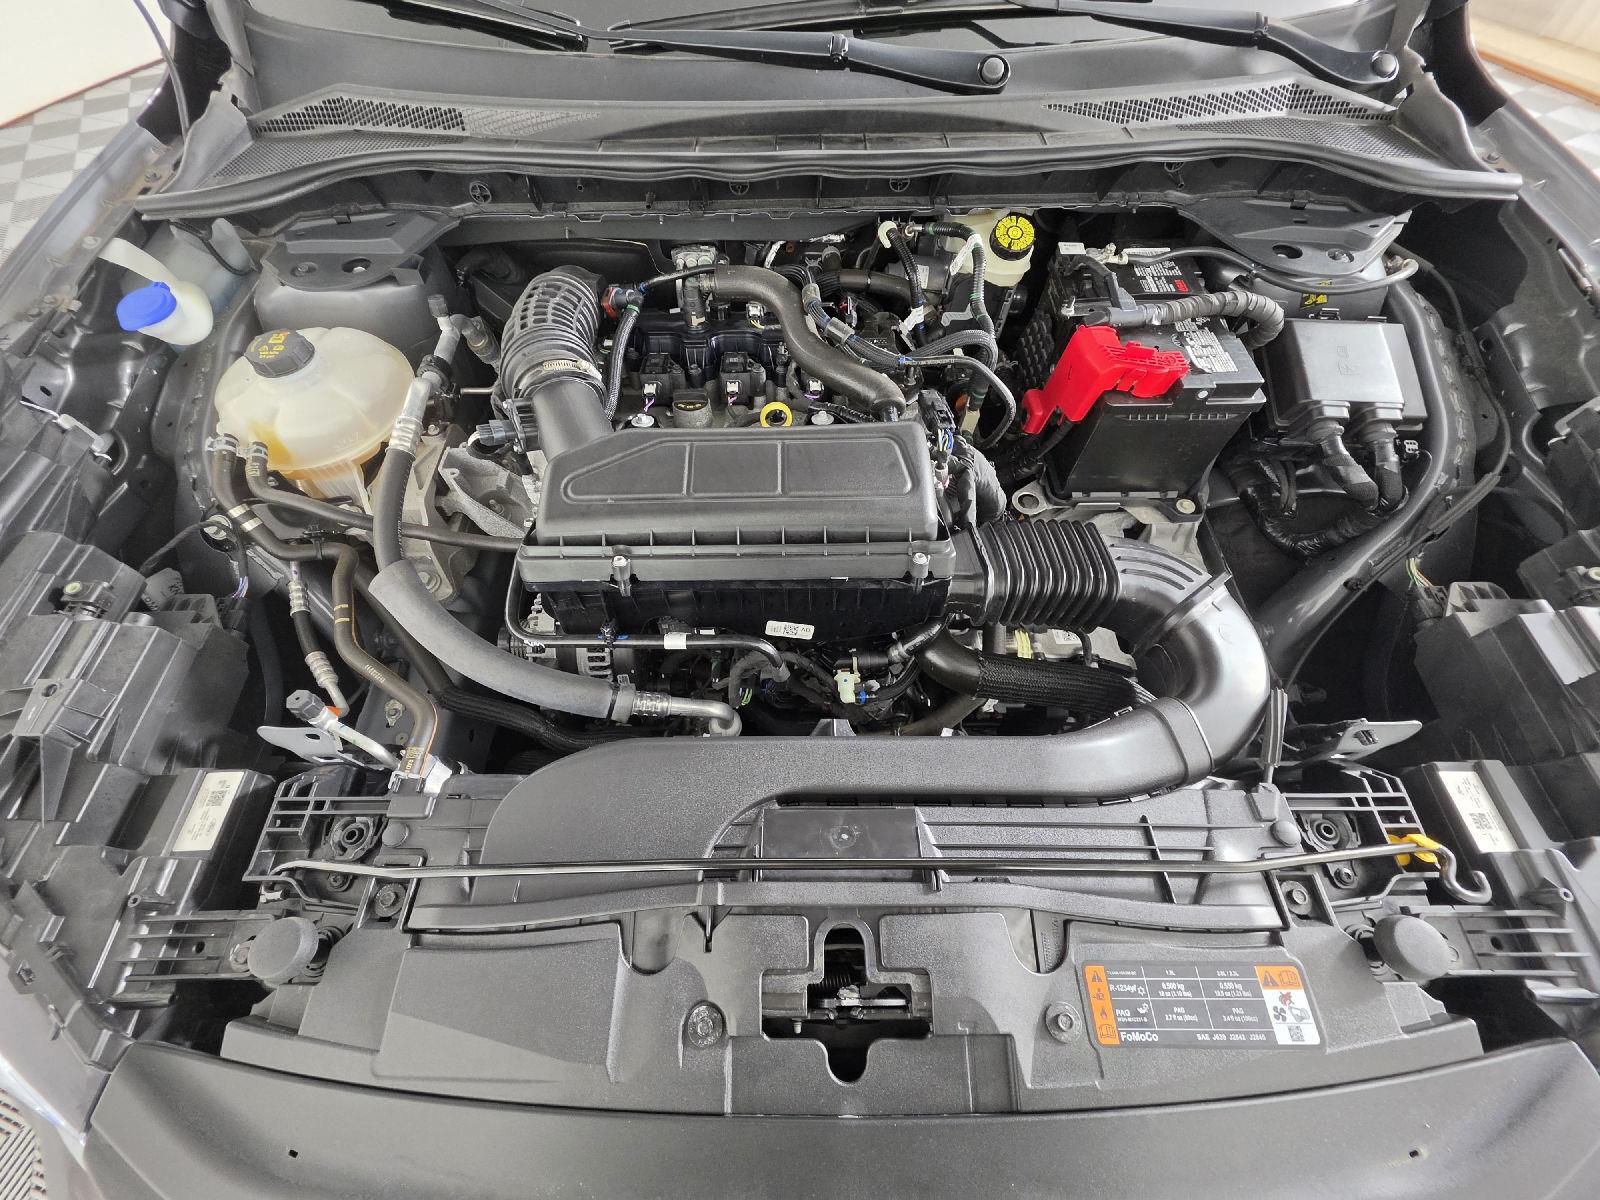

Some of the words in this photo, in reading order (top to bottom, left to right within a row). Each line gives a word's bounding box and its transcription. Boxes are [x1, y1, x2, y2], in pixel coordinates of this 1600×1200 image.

[1109, 984, 1137, 993] R-1234yf
[1115, 1008, 1131, 1017] PAG
[1173, 1006, 1186, 1014] PAG
[1120, 1031, 1159, 1042] FoMoCo
[1196, 1033, 1210, 1041] SAE
